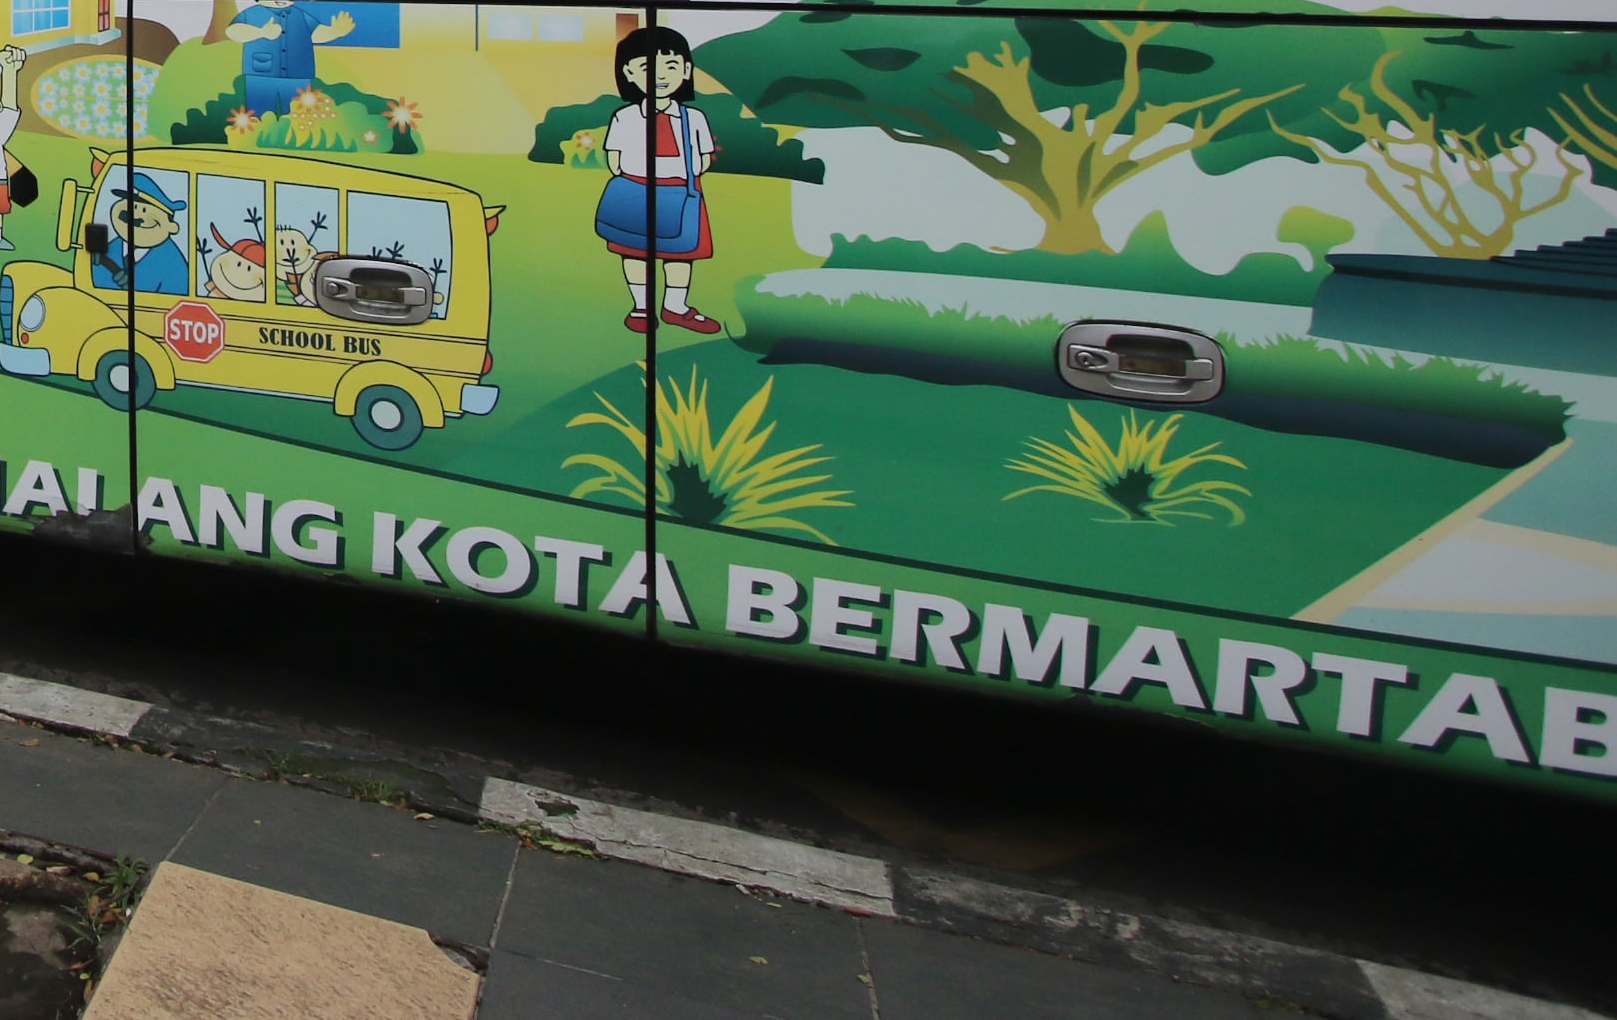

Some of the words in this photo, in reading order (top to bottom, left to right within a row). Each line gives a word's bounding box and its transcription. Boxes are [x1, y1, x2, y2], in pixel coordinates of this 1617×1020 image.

[170, 318, 219, 344] STOP
[259, 327, 336, 351] SCHOOL
[343, 336, 381, 356] BUS
[371, 511, 691, 626] KOTA
